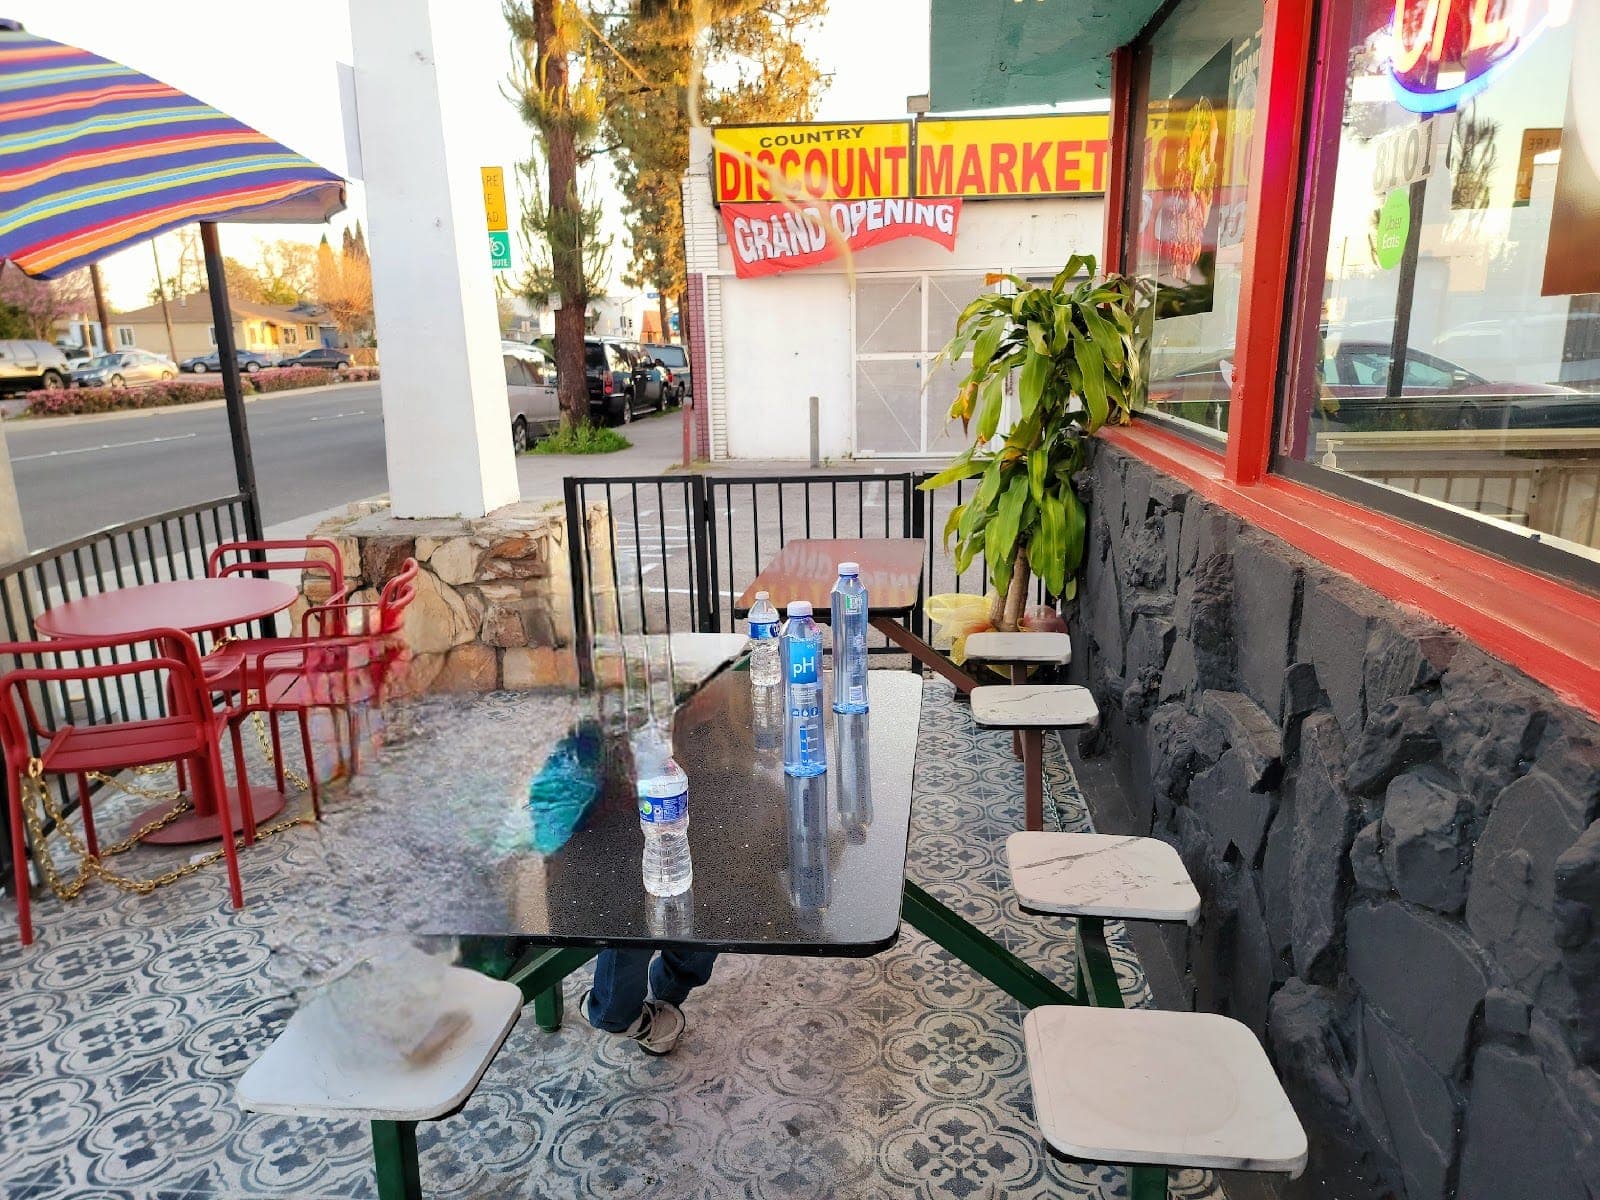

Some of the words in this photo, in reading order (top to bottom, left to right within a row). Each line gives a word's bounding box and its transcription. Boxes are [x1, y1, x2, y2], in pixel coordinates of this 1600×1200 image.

[760, 127, 864, 148] COUNTRY
[719, 146, 907, 200] DISCOUNT
[919, 139, 1109, 195] MARKET
[733, 207, 827, 264] GRAND
[829, 198, 954, 241] OPENING
[1381, 233, 1402, 250] Eats
[793, 655, 815, 678] pH
